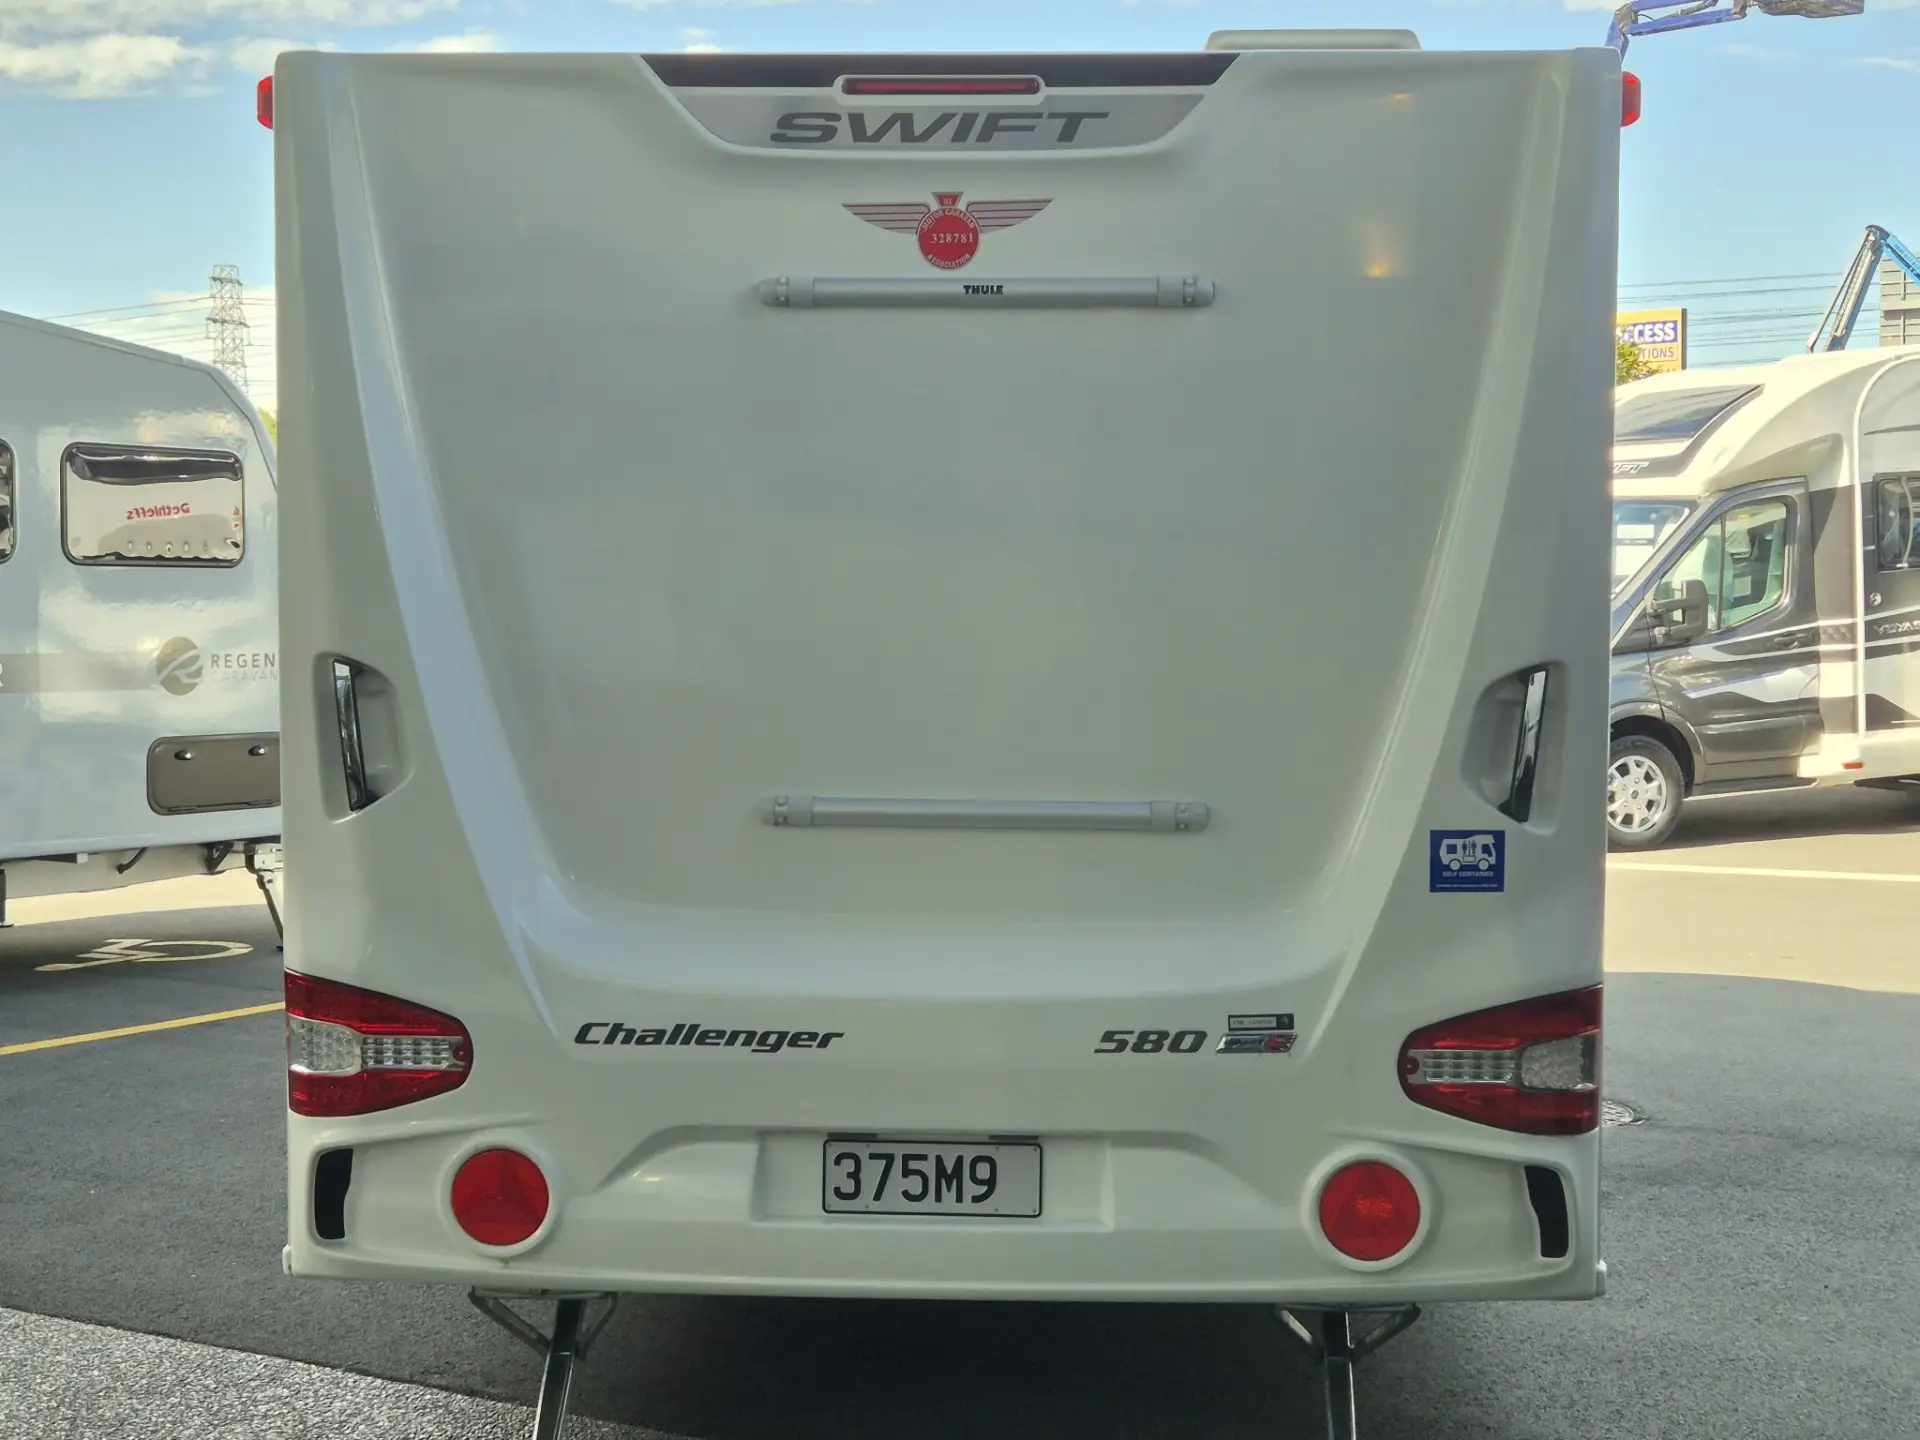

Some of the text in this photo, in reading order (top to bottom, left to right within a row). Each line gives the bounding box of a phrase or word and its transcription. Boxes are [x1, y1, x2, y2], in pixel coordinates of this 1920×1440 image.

[770, 112, 1109, 143] SWIFT
[922, 208, 976, 231] MOTOR CARAVAN
[930, 232, 973, 244] 328781
[927, 253, 971, 268] ASSOCIATION
[963, 284, 1004, 295] THULE
[210, 652, 276, 669] REGEN
[574, 1022, 845, 1053] Challenger
[1093, 1030, 1208, 1053] 580
[833, 1152, 998, 1204] 375M9
